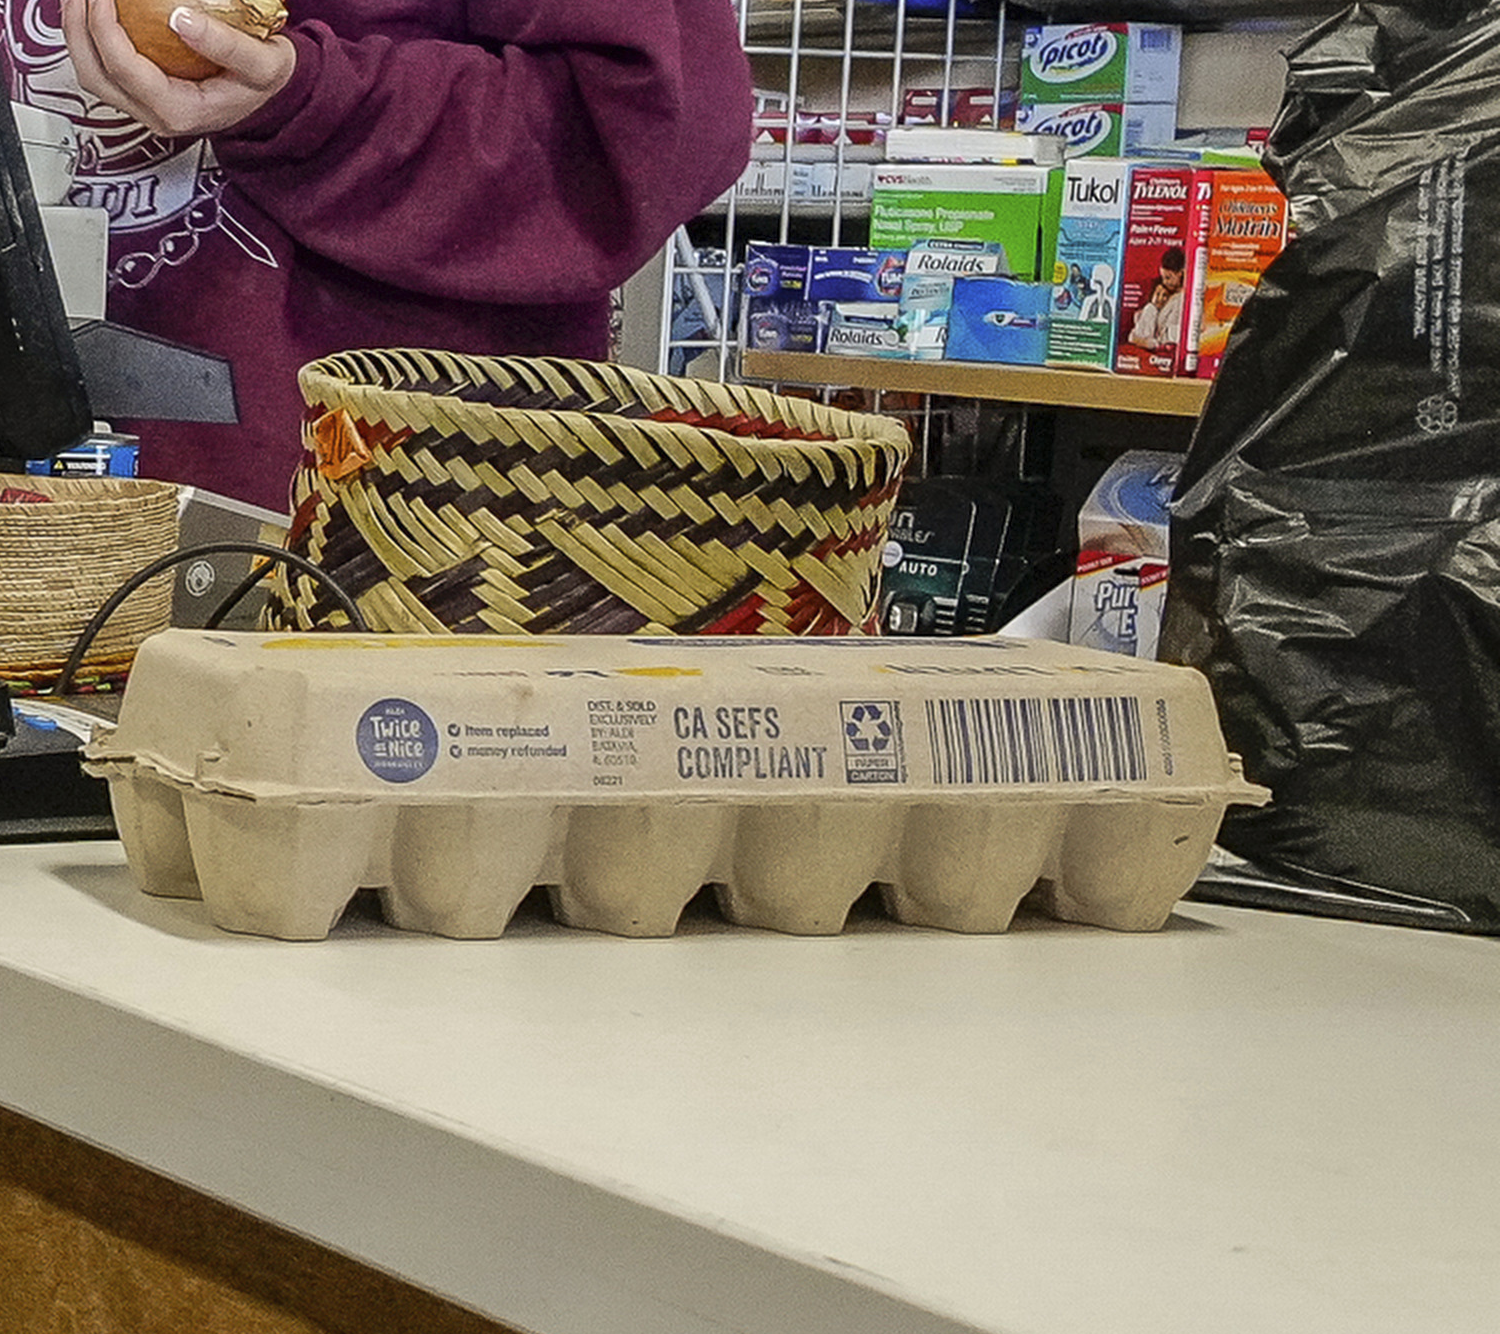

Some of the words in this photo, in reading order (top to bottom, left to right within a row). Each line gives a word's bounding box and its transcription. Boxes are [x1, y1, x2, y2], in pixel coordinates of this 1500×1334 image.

[1040, 33, 1100, 73] picot
[1067, 176, 1120, 204] Tukol
[1133, 182, 1188, 200] TYLENOL
[873, 218, 901, 231] Nasal
[1215, 216, 1280, 238] Motrin
[917, 253, 986, 274] Rolaids
[830, 326, 883, 346] Rolaids
[899, 562, 938, 578] AUTO
[626, 701, 656, 712] SOLD
[369, 715, 422, 738] Twice
[589, 714, 657, 726] EXCLUSIVELY
[673, 706, 709, 740] CA
[716, 706, 781, 739] SEFS
[465, 724, 493, 737] Item
[496, 724, 551, 739] replaced
[388, 738, 425, 758] Nice
[467, 746, 508, 759] money
[510, 744, 567, 758] refunded
[677, 744, 828, 780] COMPLIANT
